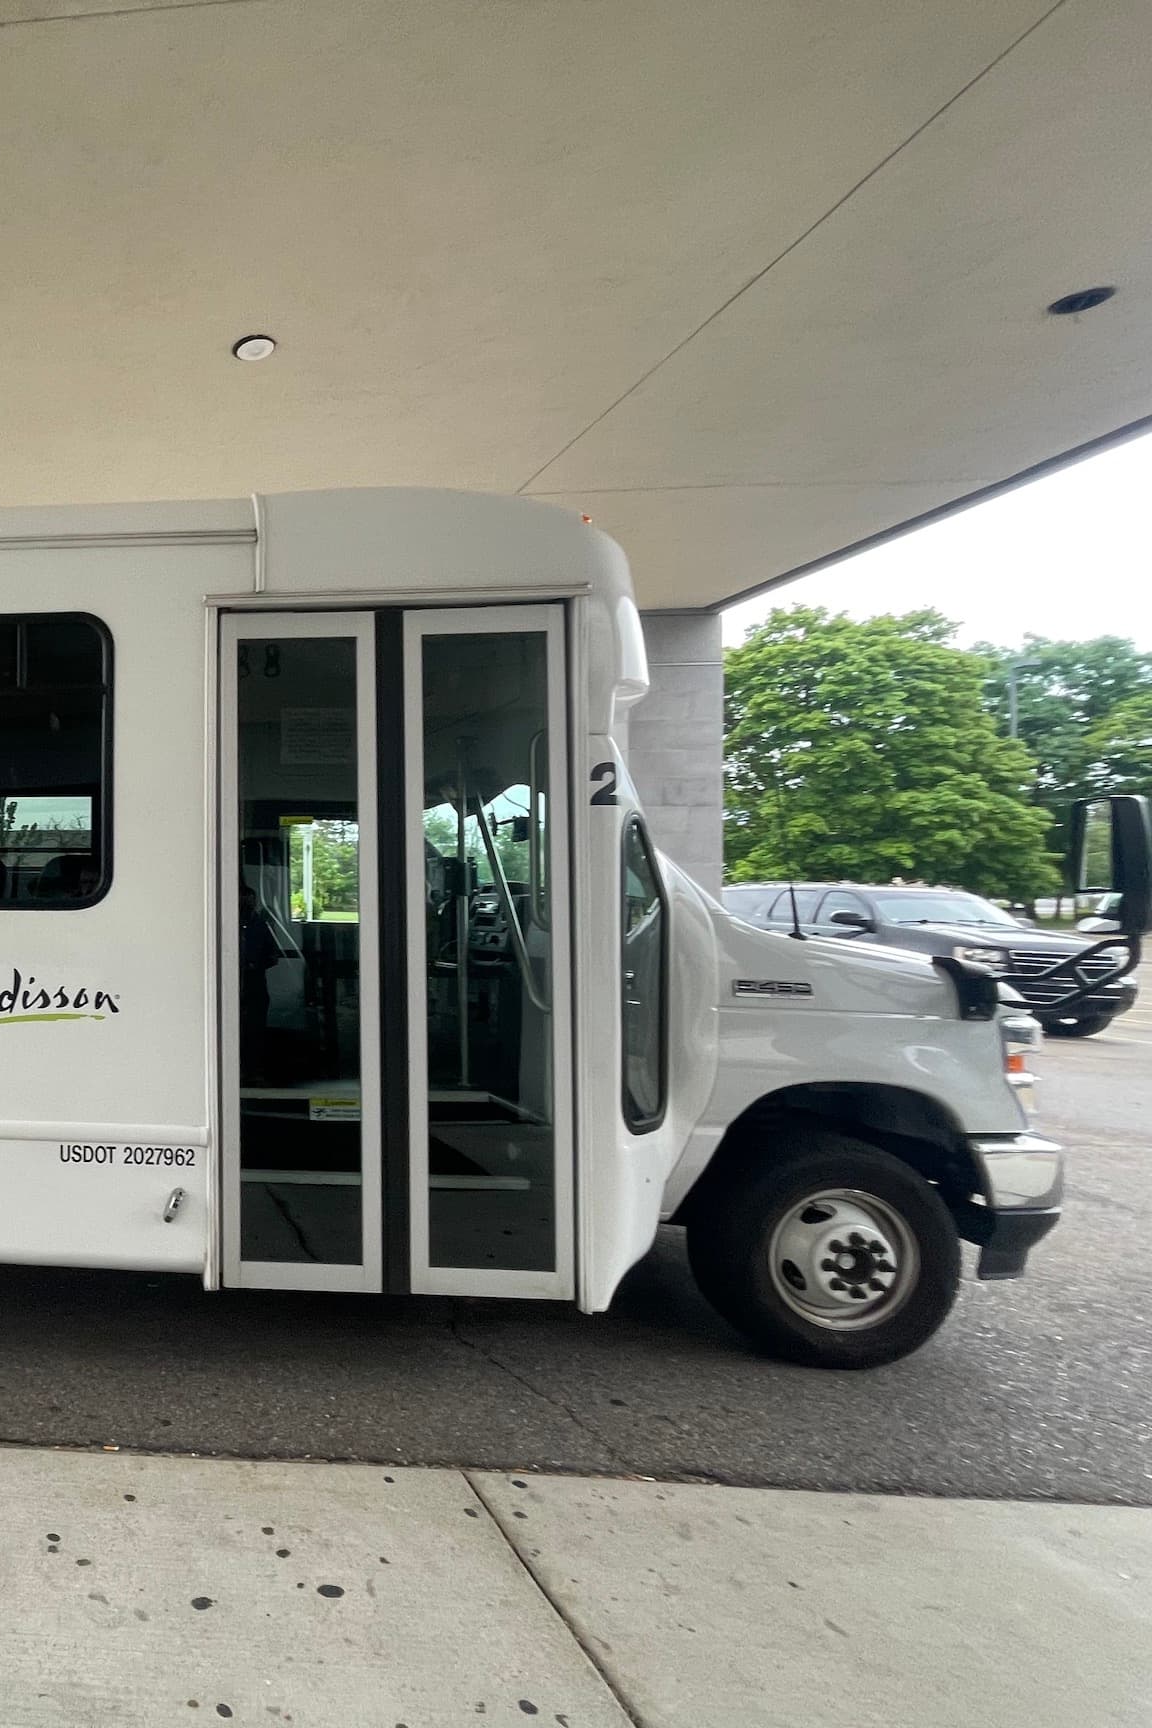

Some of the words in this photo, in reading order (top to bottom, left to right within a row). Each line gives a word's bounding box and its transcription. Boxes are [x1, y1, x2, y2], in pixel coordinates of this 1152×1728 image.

[590, 761, 618, 806] 2
[60, 1144, 116, 1164] USDOT
[123, 1146, 196, 1167] 2027962
